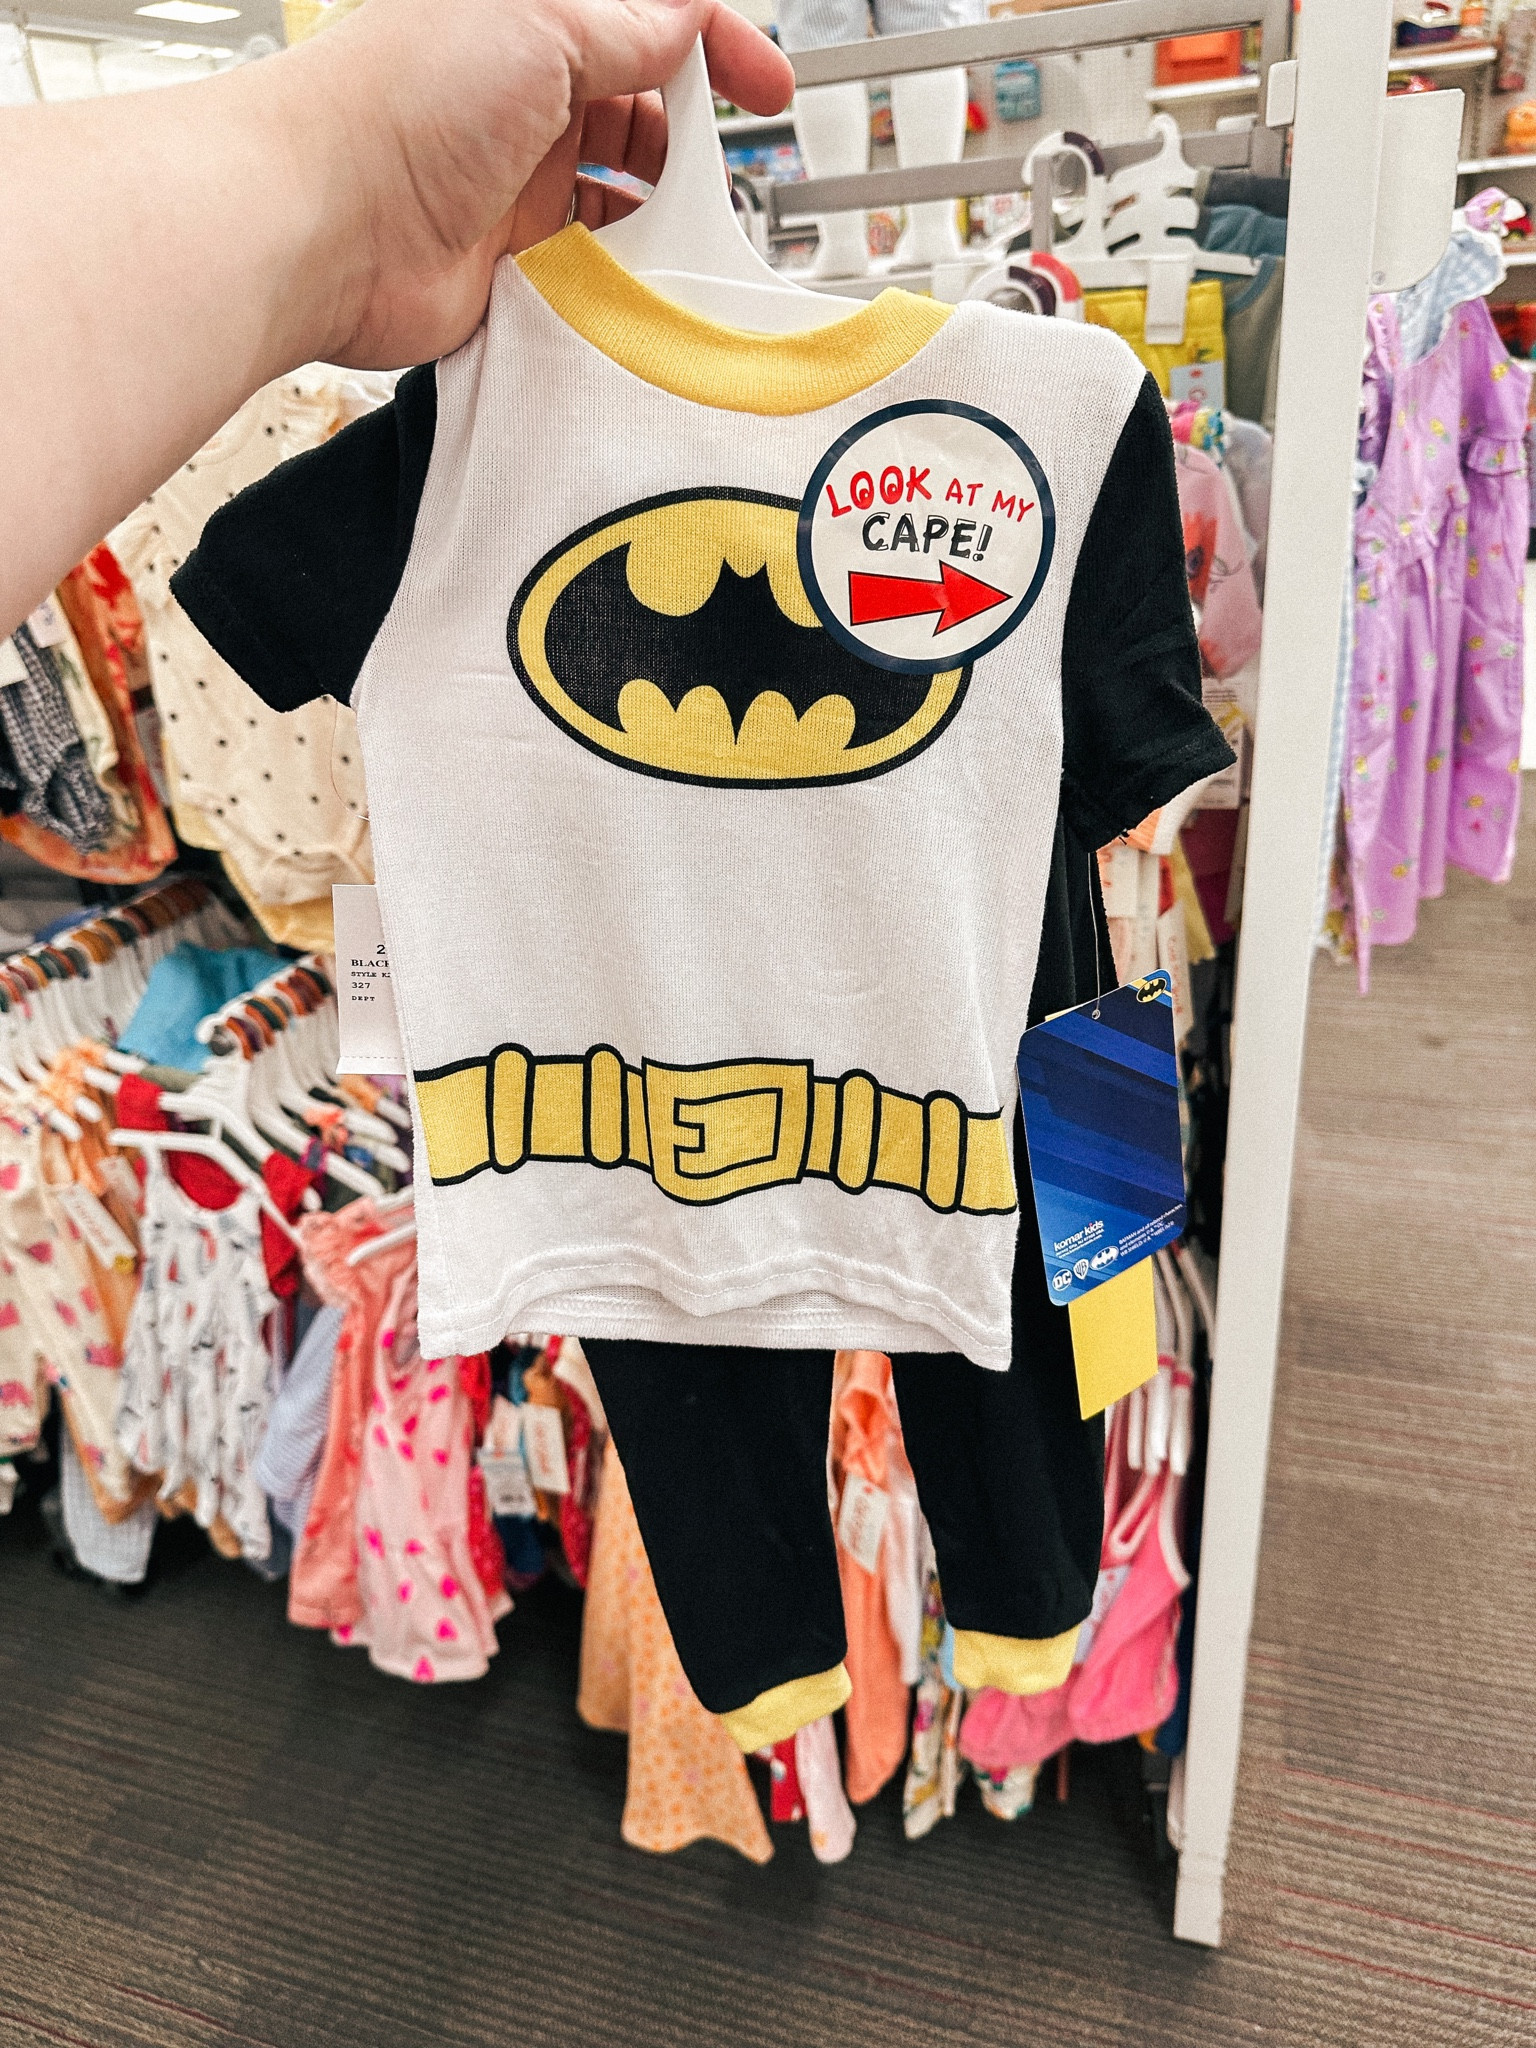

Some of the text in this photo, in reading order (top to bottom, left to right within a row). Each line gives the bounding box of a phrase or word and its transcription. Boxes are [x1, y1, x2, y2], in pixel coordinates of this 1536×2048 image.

[825, 465, 1034, 522] LOOK AT MY
[862, 511, 993, 562] CAPE!
[1053, 1230, 1084, 1252] komar
[1084, 1220, 1104, 1236] kids
[1053, 1271, 1072, 1289] DC
